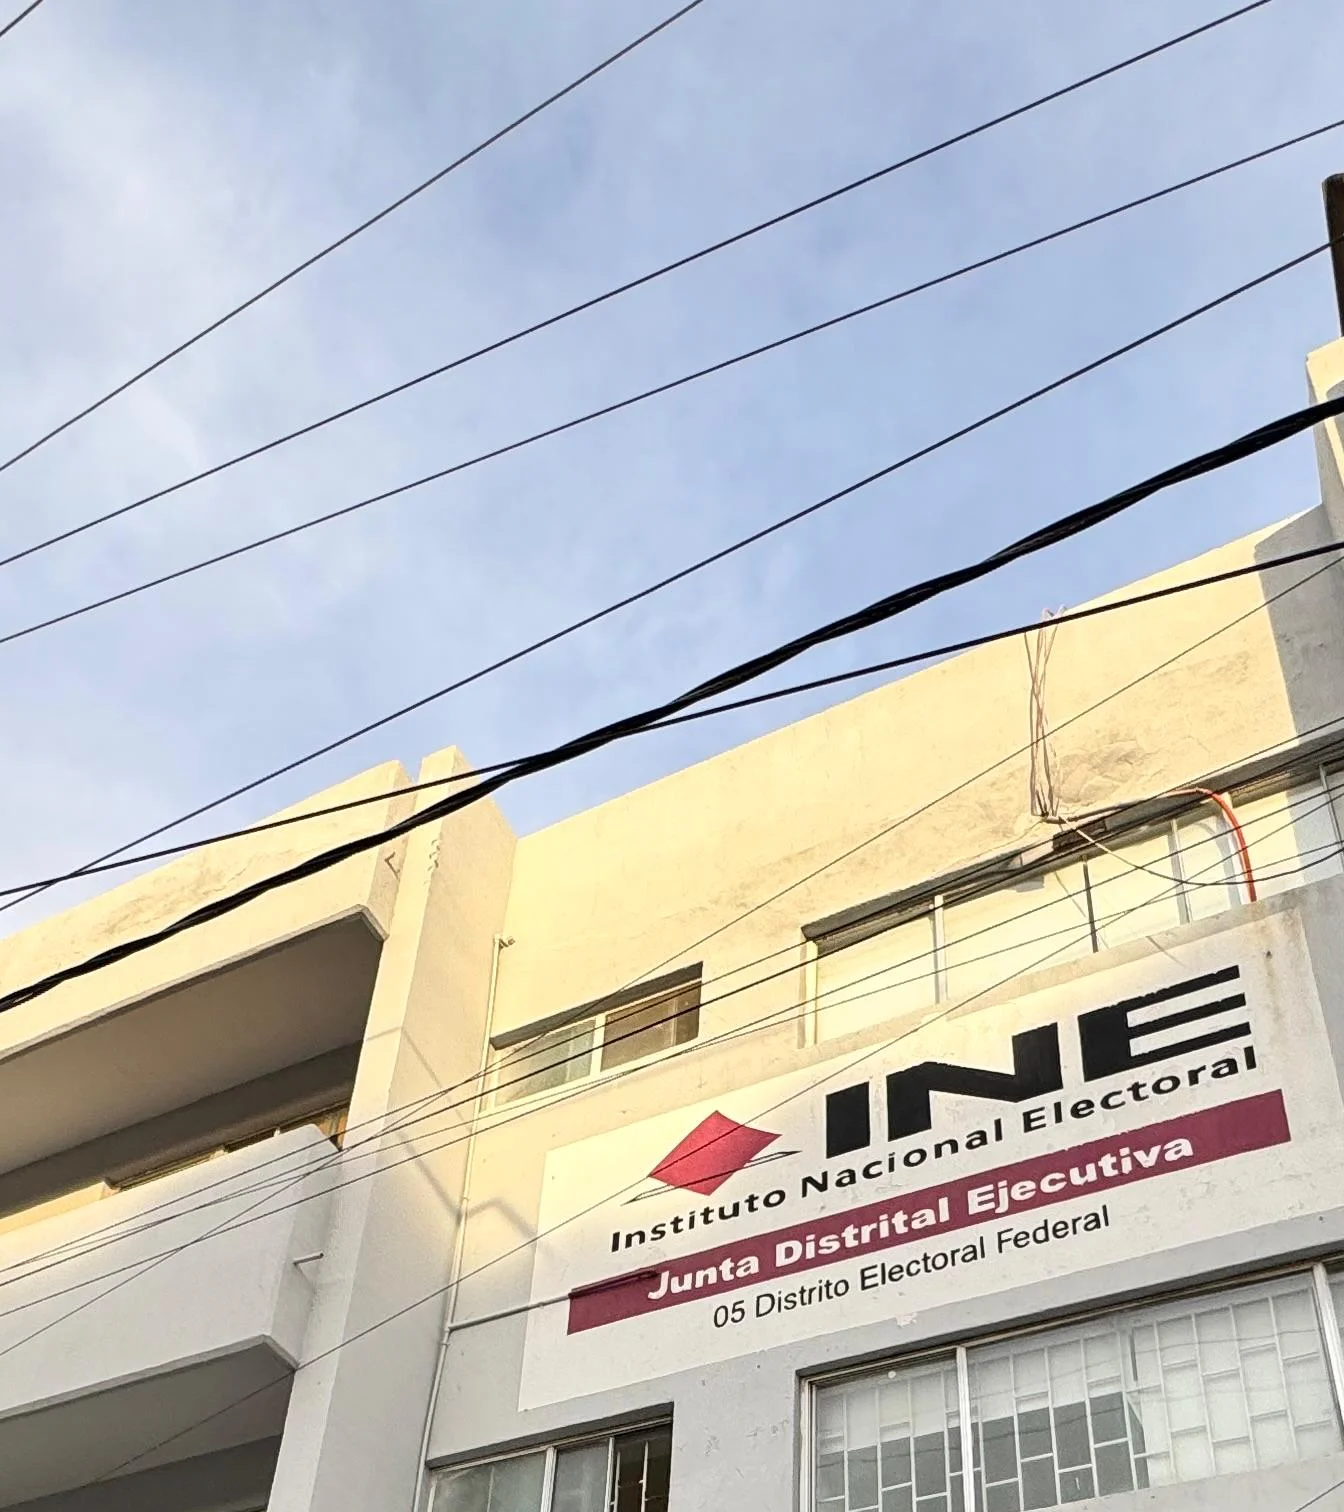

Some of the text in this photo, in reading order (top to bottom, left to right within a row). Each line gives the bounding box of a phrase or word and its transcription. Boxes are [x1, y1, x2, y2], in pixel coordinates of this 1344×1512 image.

[611, 1045, 1257, 1253] Instituto Nacional Electoral
[826, 964, 1252, 1159] INE
[648, 1135, 1194, 1301] Junta Distrital Ejecutiva
[713, 1204, 1110, 1329] 05 Distrito Electoral Federal
